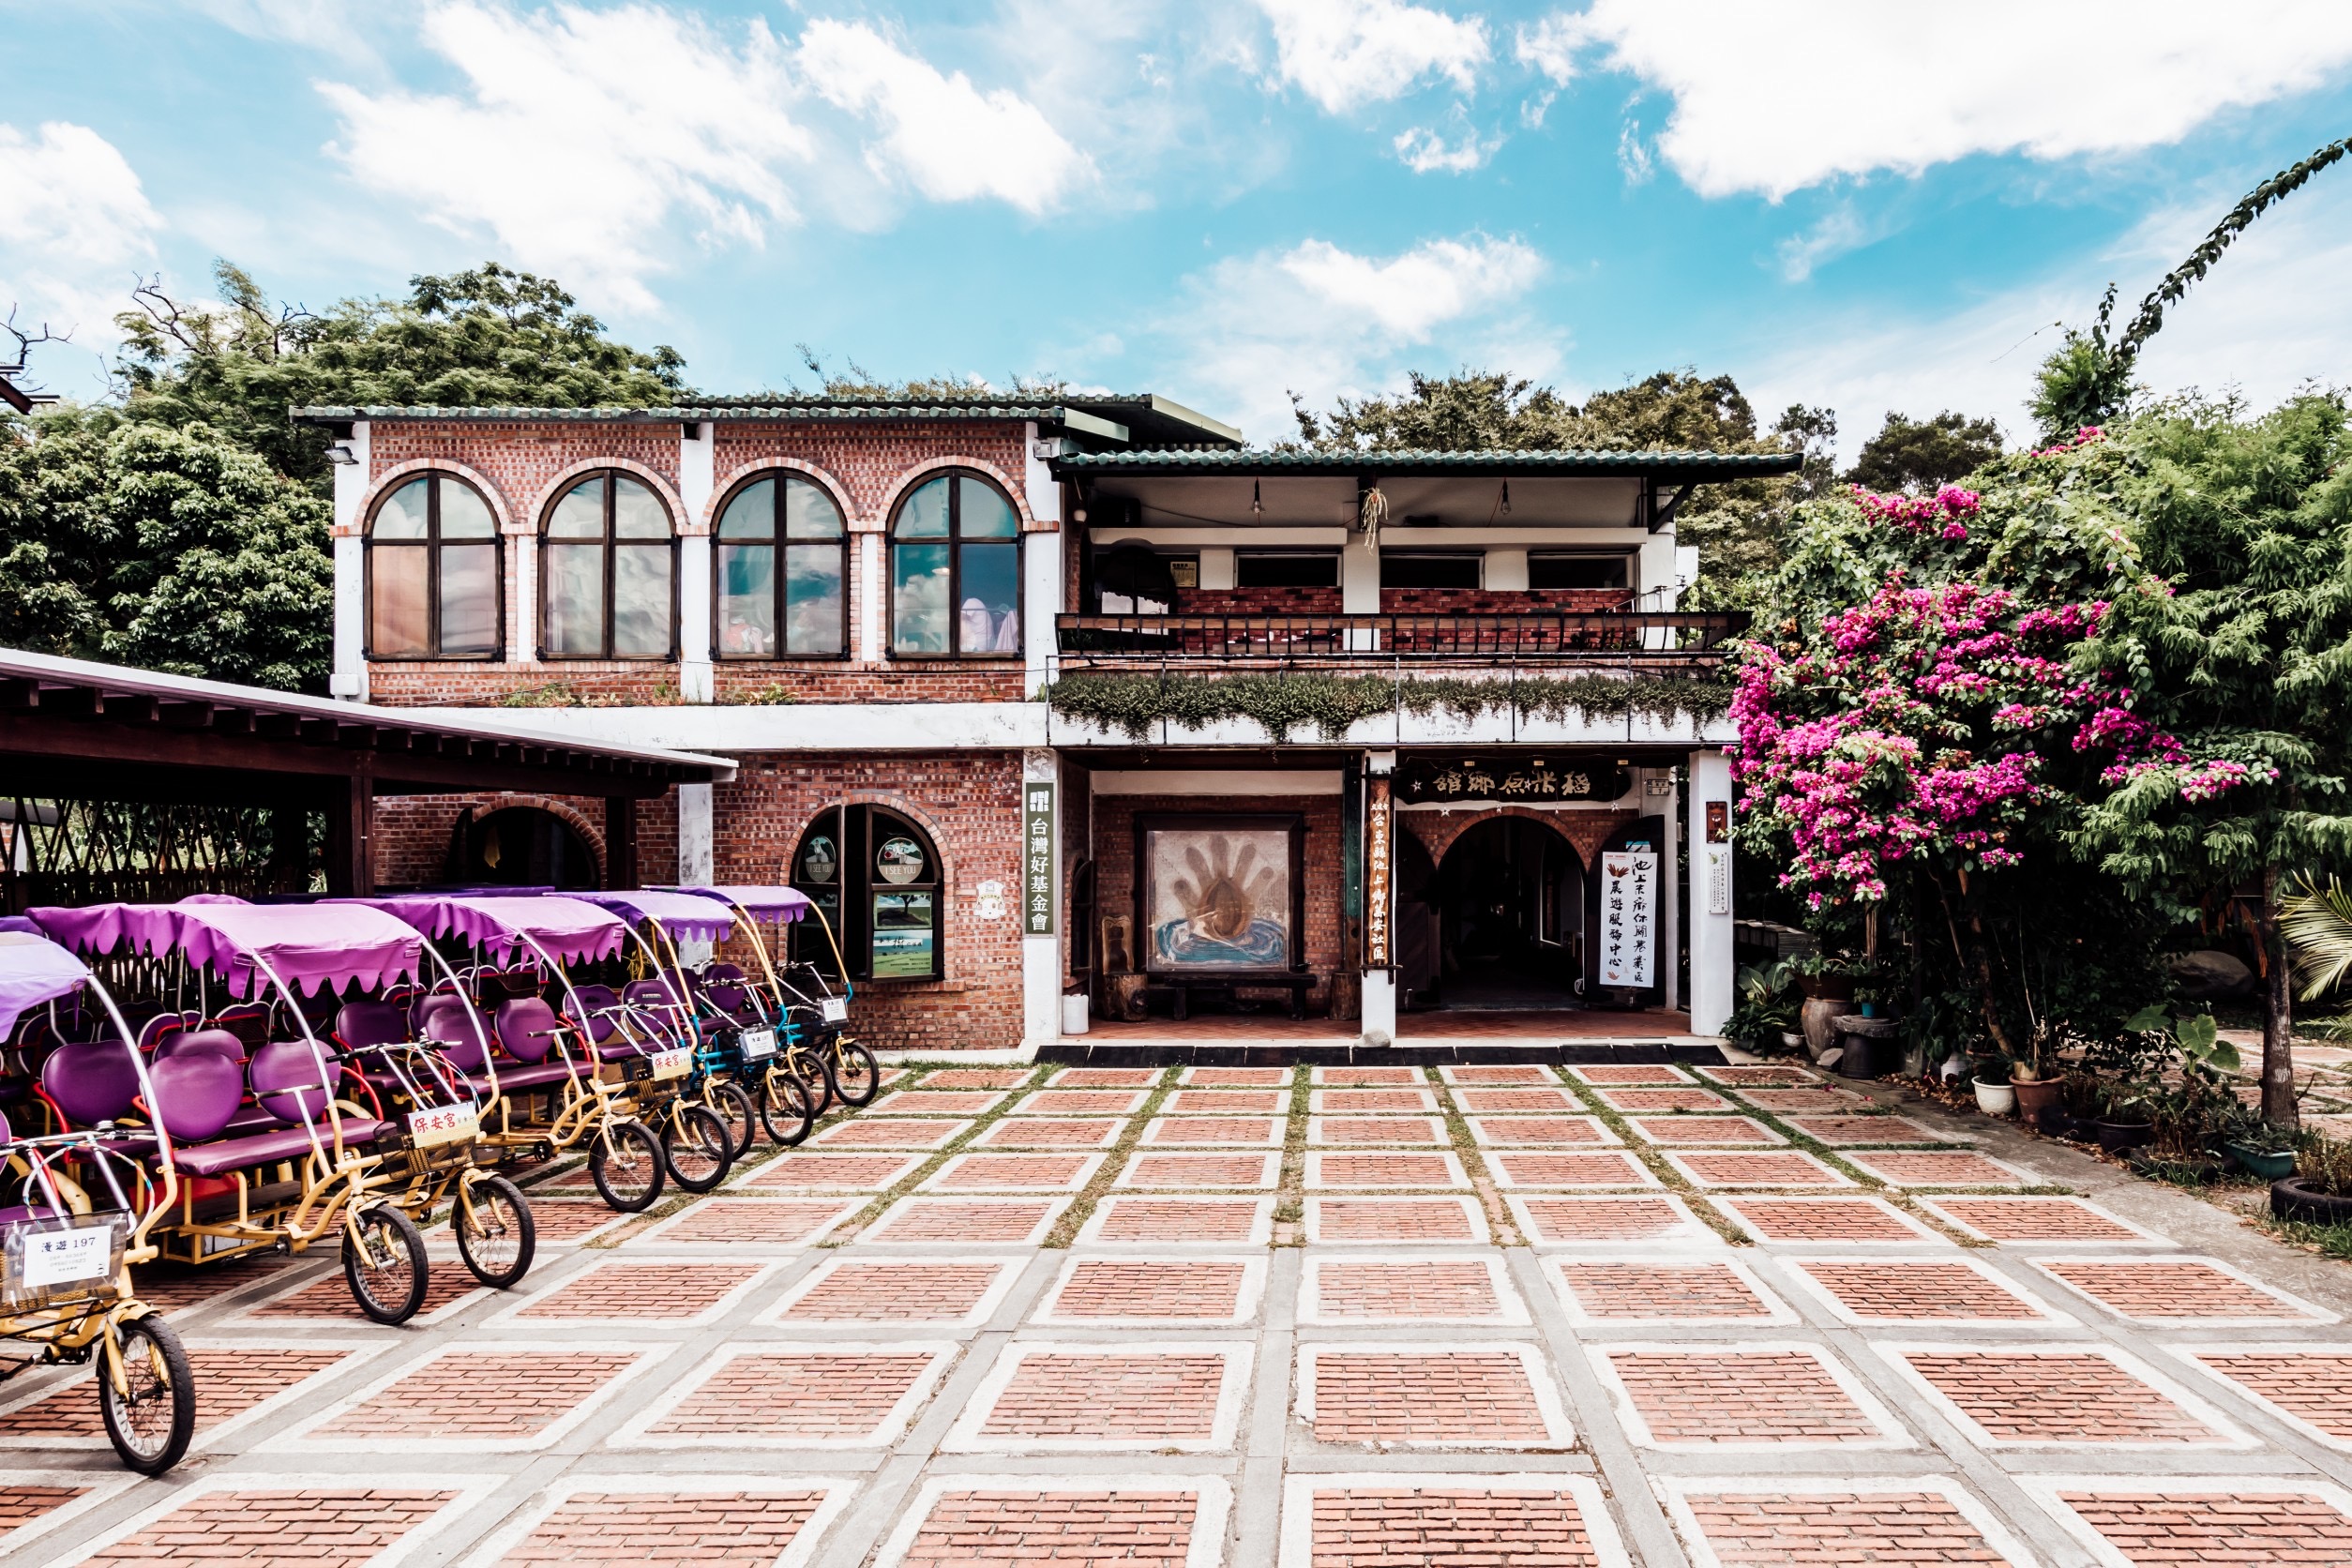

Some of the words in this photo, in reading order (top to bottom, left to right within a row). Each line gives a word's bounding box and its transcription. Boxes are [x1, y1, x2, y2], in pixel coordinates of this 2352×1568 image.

[889, 867, 901, 875] SEE
[902, 866, 916, 875] YOU
[1031, 818, 1049, 931] 台灣好基金會
[414, 1112, 456, 1134] 保安宮
[73, 1237, 97, 1248] 197
